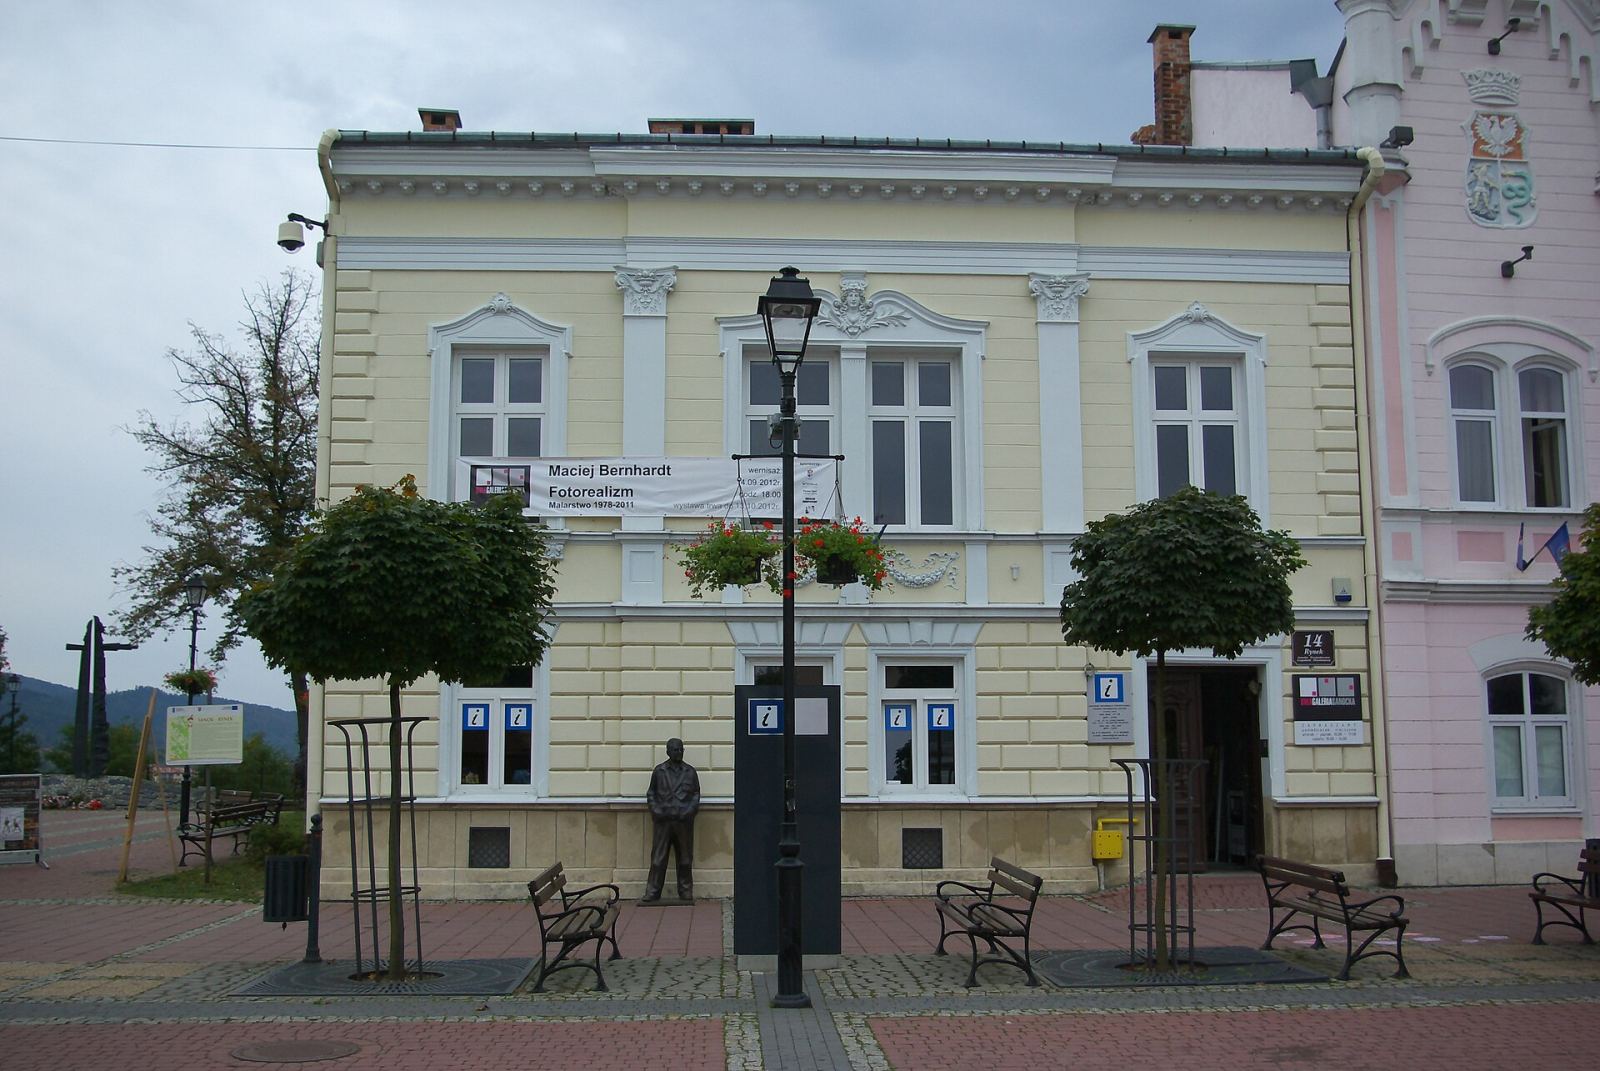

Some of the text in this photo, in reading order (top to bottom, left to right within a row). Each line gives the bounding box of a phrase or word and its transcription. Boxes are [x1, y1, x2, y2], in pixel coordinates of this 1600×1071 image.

[549, 464, 672, 479] Maciej Bernhardt
[739, 478, 782, 486] 4.09.2012r.
[549, 486, 634, 498] Fotorealizm
[762, 490, 781, 498] 18.00
[549, 501, 635, 509] Malarstwo 1978-2011
[1304, 633, 1323, 648] 14
[1304, 648, 1324, 656] Rynek
